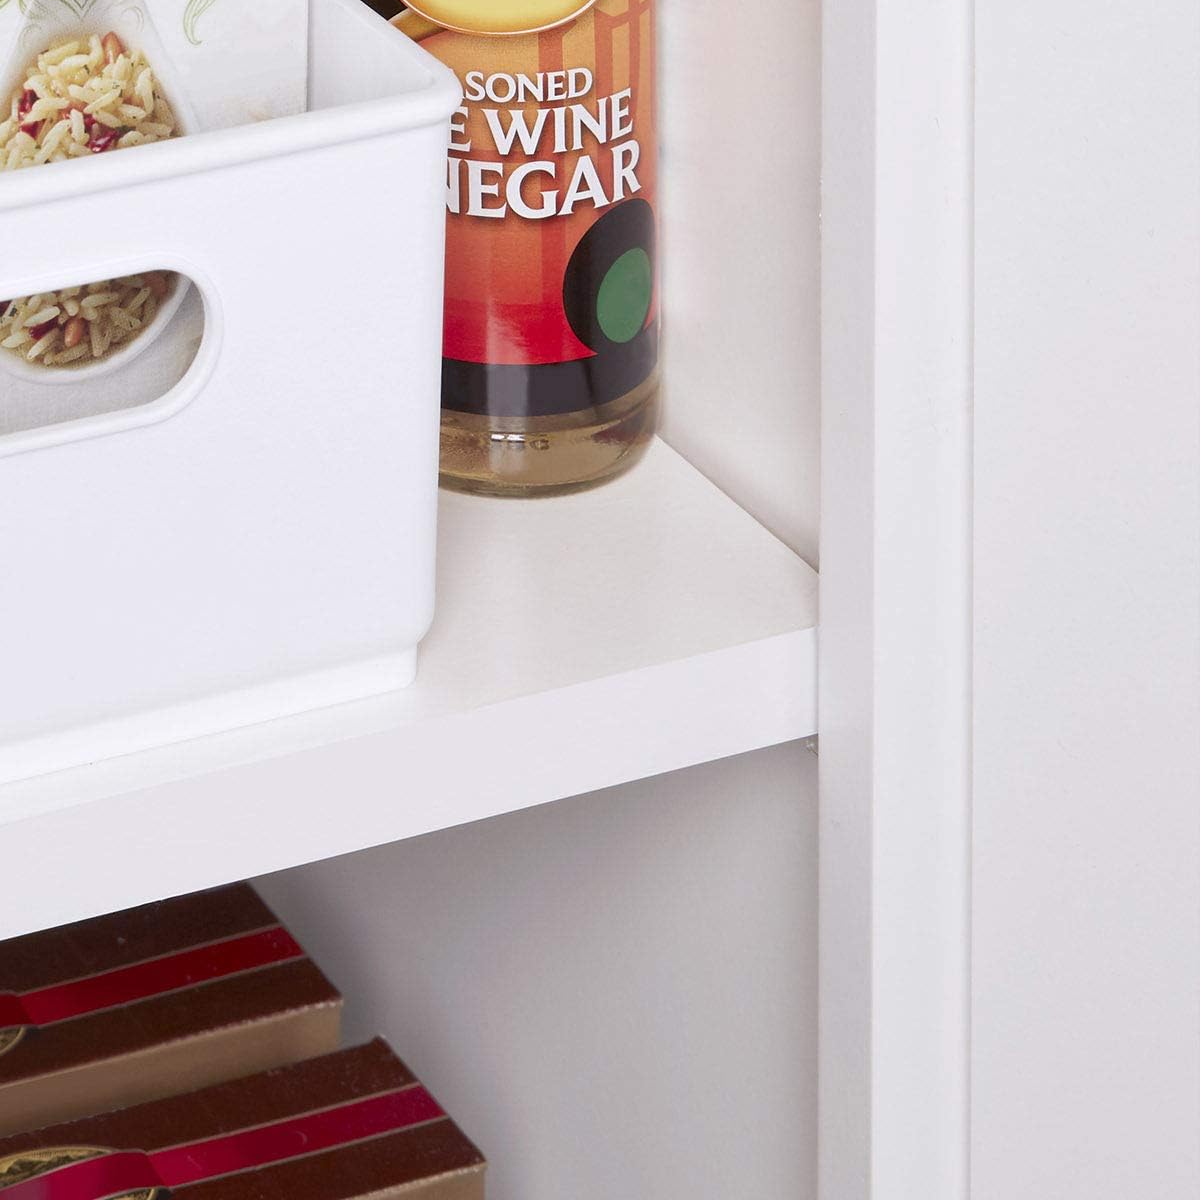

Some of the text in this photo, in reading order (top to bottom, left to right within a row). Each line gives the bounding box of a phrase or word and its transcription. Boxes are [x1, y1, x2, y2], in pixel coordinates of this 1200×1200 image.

[464, 67, 593, 103] SONED
[481, 87, 633, 156] WINE
[446, 139, 642, 220] NEGAR
